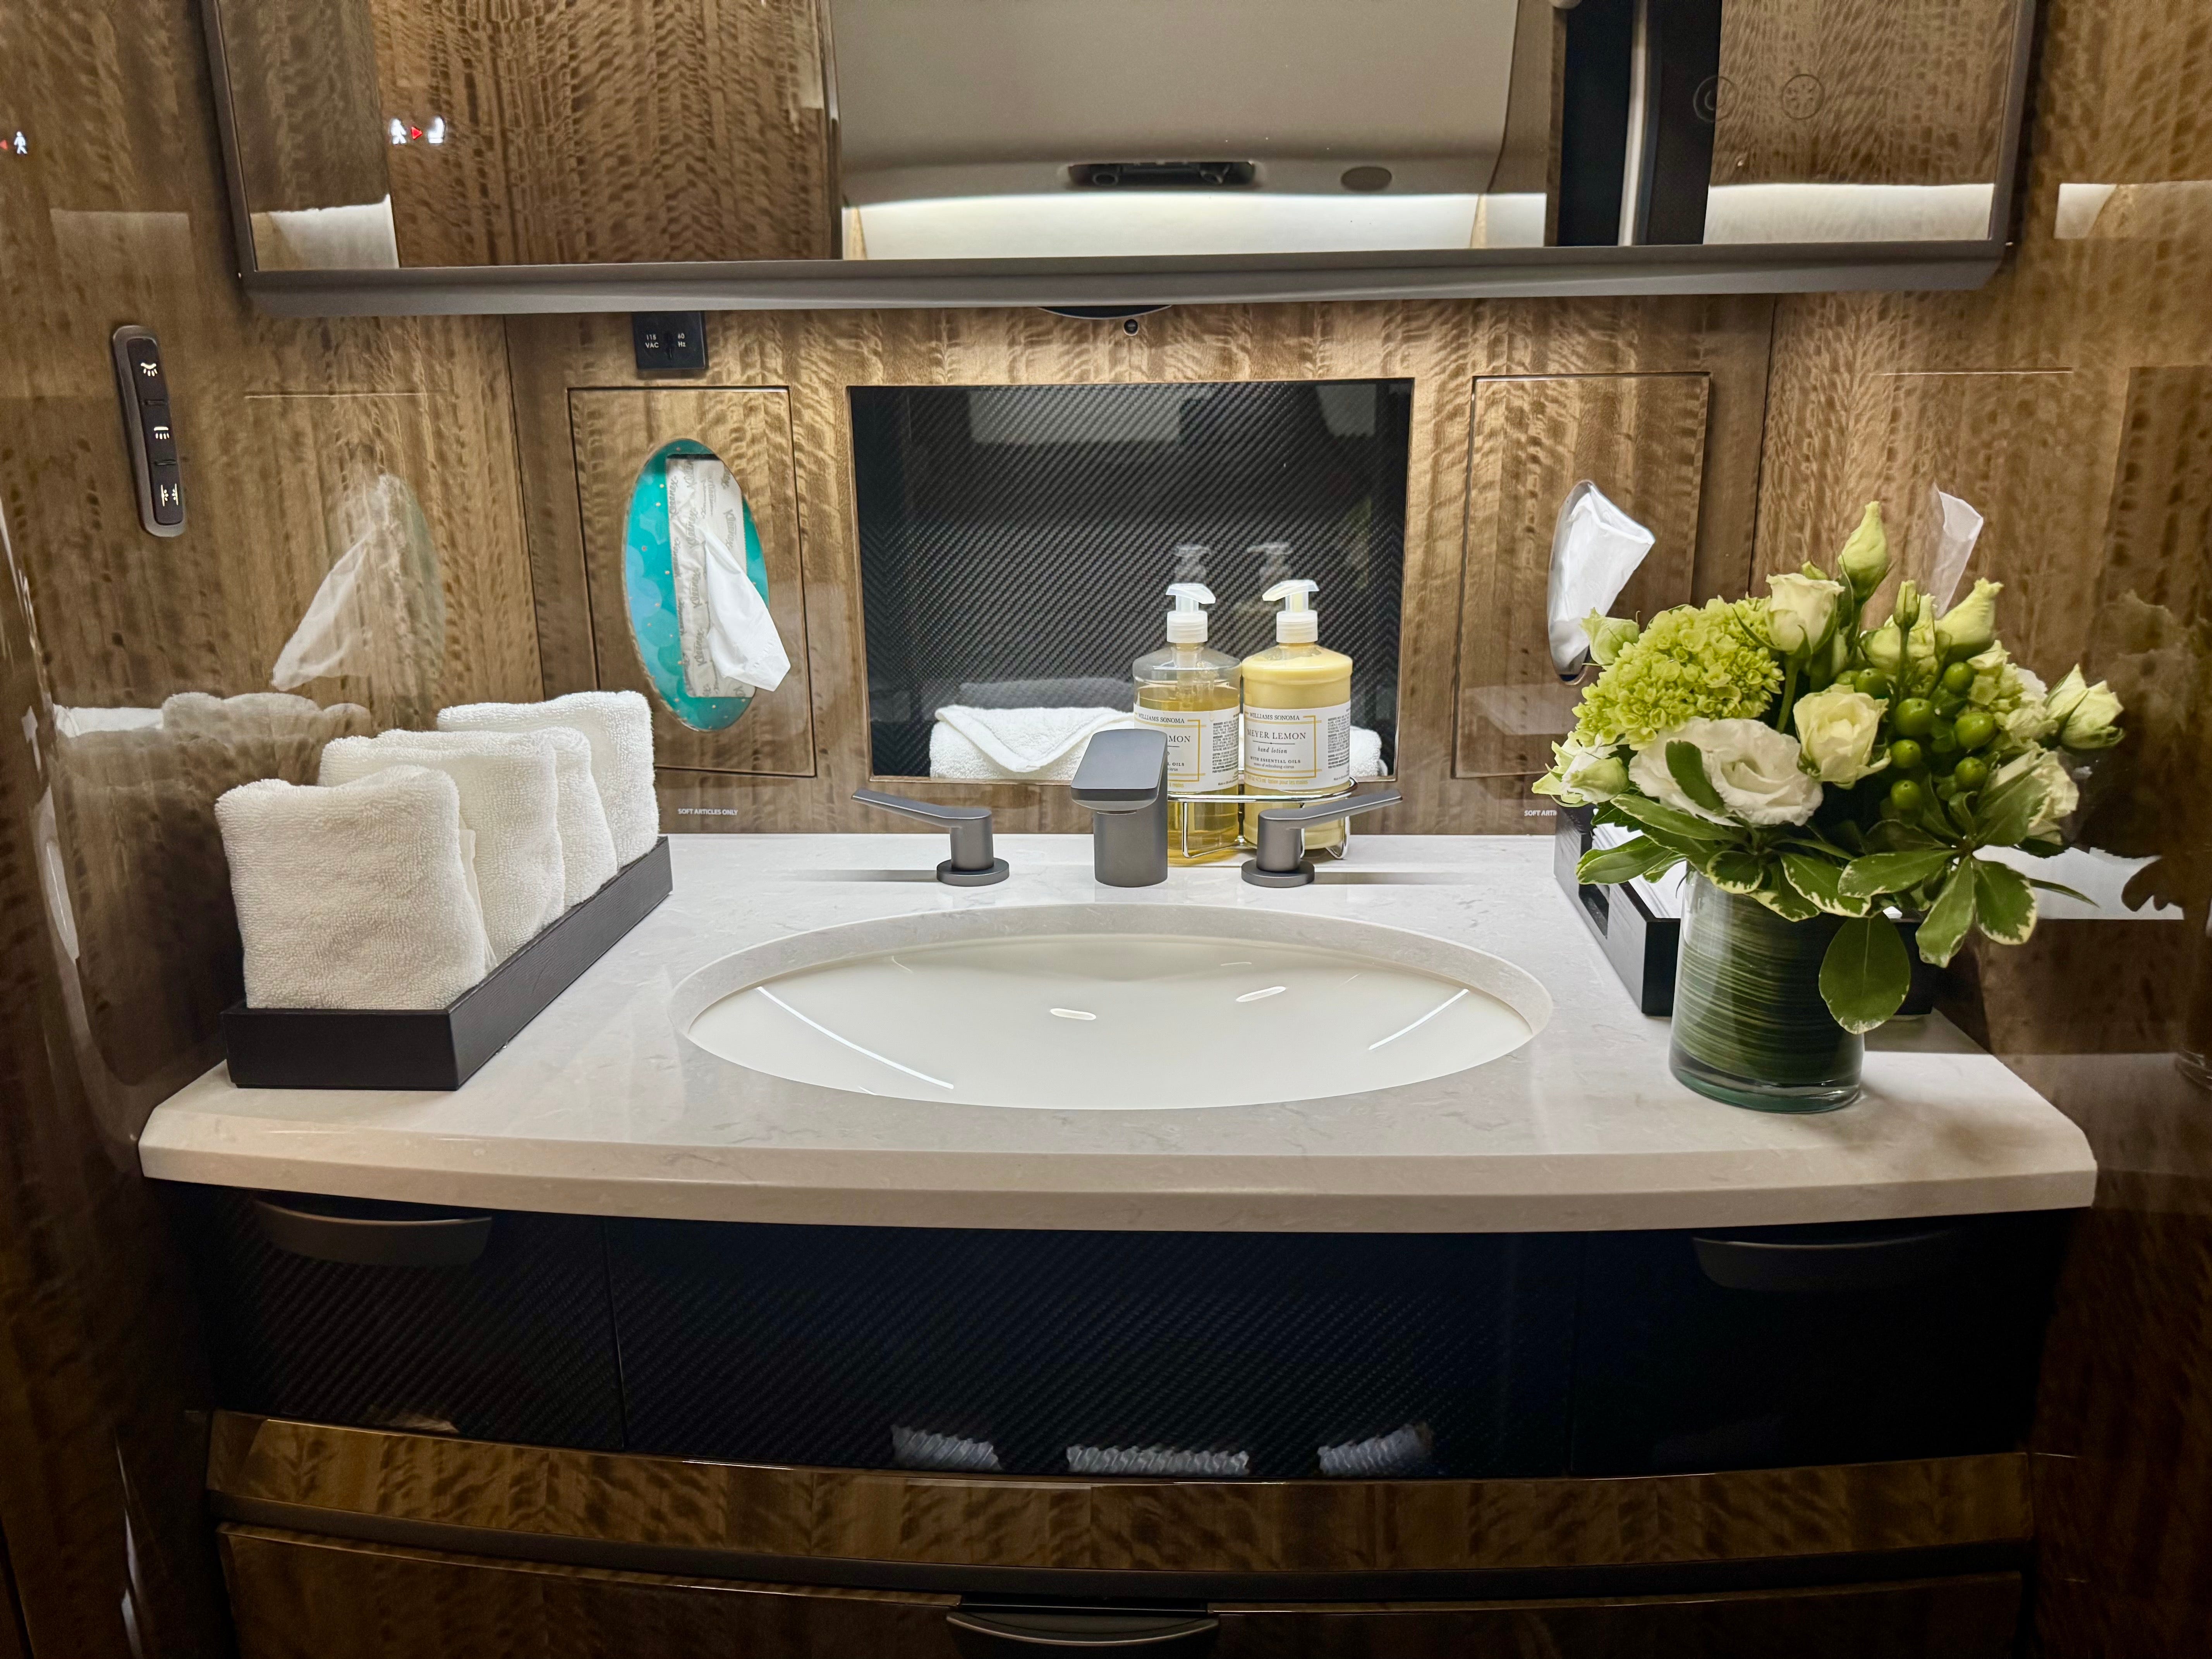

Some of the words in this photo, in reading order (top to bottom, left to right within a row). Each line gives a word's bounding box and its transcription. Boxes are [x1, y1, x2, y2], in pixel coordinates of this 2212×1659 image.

[723, 509, 737, 550] Kleenex
[690, 568, 702, 608] Kleenex
[694, 627, 707, 666] Kleenex
[1139, 713, 1159, 721] WILLIAMS
[1247, 728, 1269, 738] MEYER
